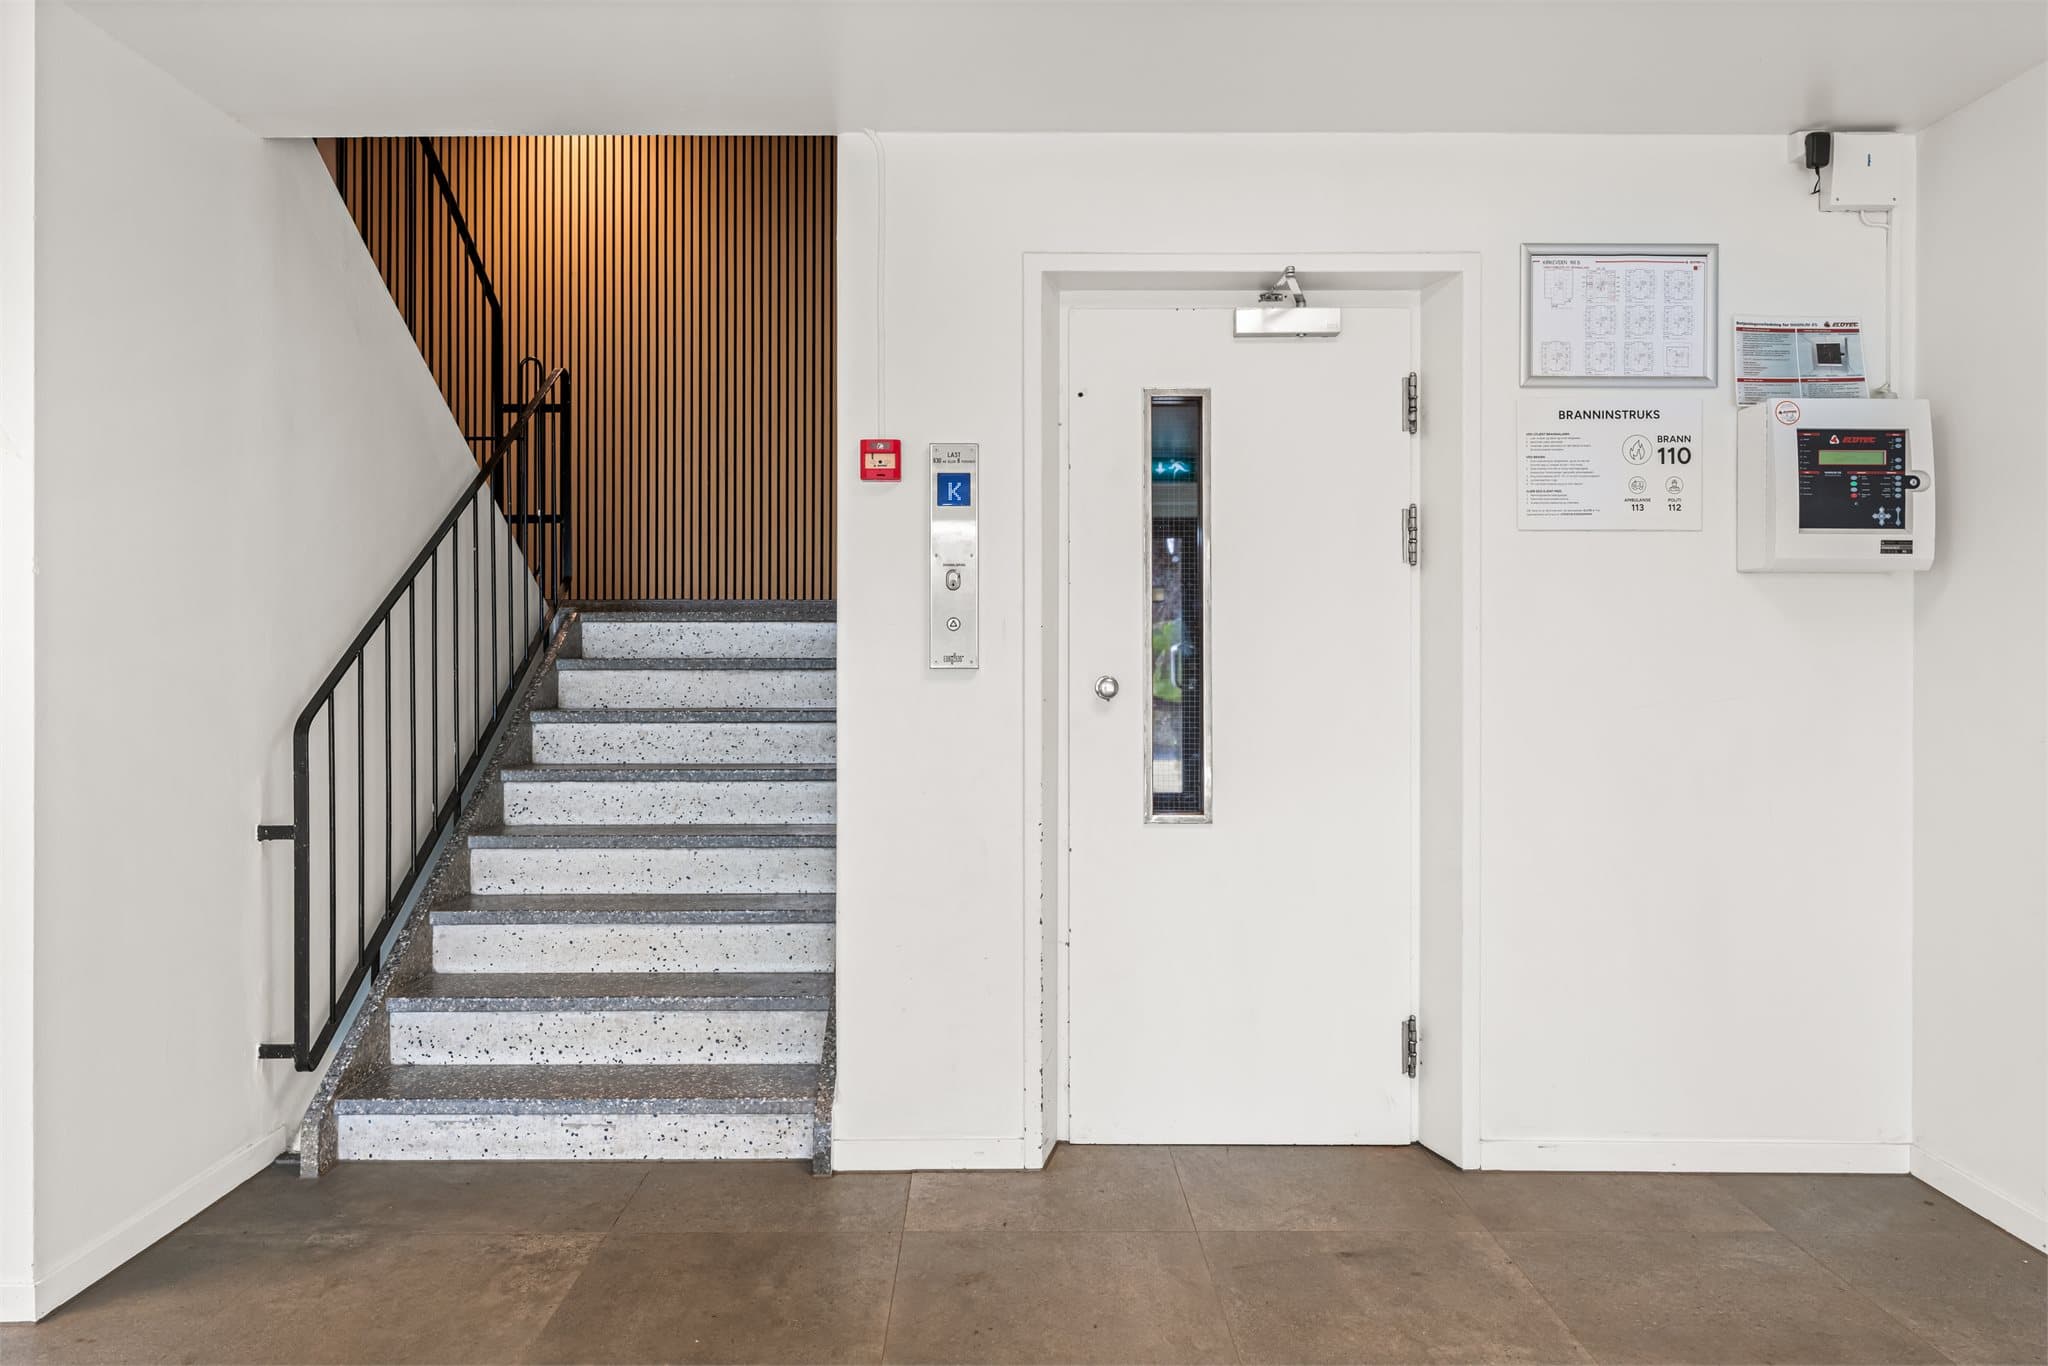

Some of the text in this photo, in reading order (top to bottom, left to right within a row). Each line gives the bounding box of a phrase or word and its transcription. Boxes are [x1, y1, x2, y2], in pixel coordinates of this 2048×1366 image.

[1558, 409, 1661, 420] BRANNINSTRUKS
[1657, 435, 1692, 443] BRANN
[1657, 447, 1692, 465] 110
[947, 482, 962, 501] K
[1631, 503, 1645, 512] 113
[1668, 503, 1682, 512] 112
